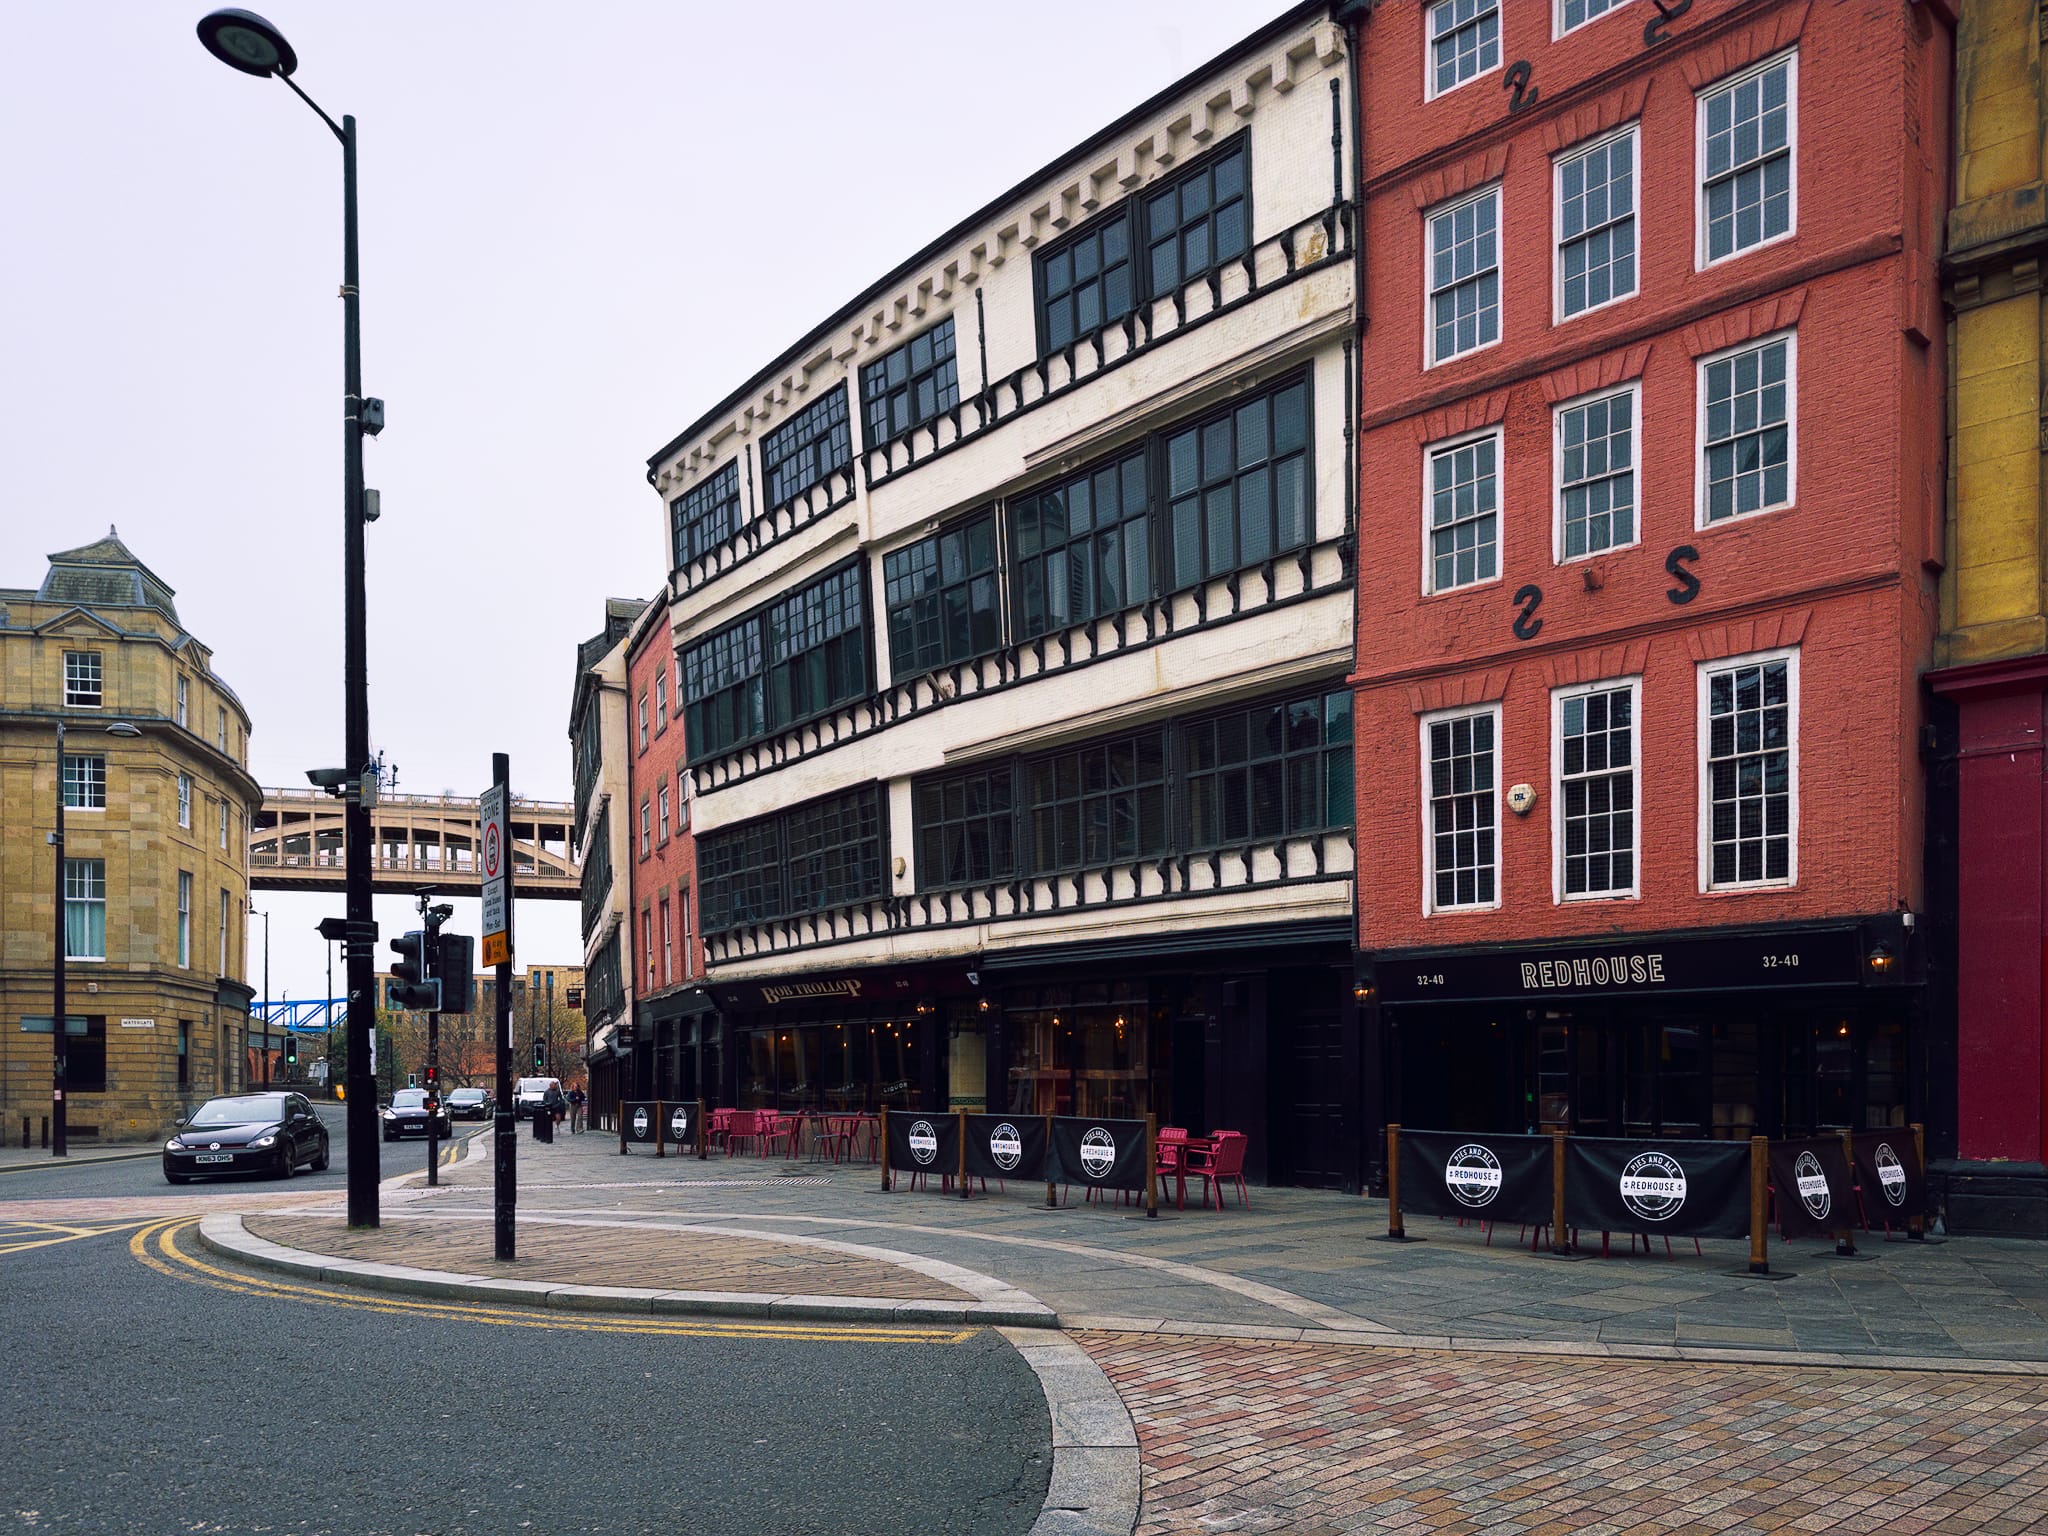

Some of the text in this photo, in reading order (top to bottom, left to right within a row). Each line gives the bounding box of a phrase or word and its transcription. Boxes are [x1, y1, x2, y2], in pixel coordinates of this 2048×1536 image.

[484, 801, 499, 821] ZONE
[1762, 954, 1799, 967] 32-40
[1520, 954, 1665, 988] REDHOUSE
[1416, 974, 1444, 985] 32-40
[760, 979, 862, 1004] BOB TROLLOP
[1454, 1170, 1492, 1180] REDHOUSE
[1630, 1181, 1675, 1191] REDHOUSE
